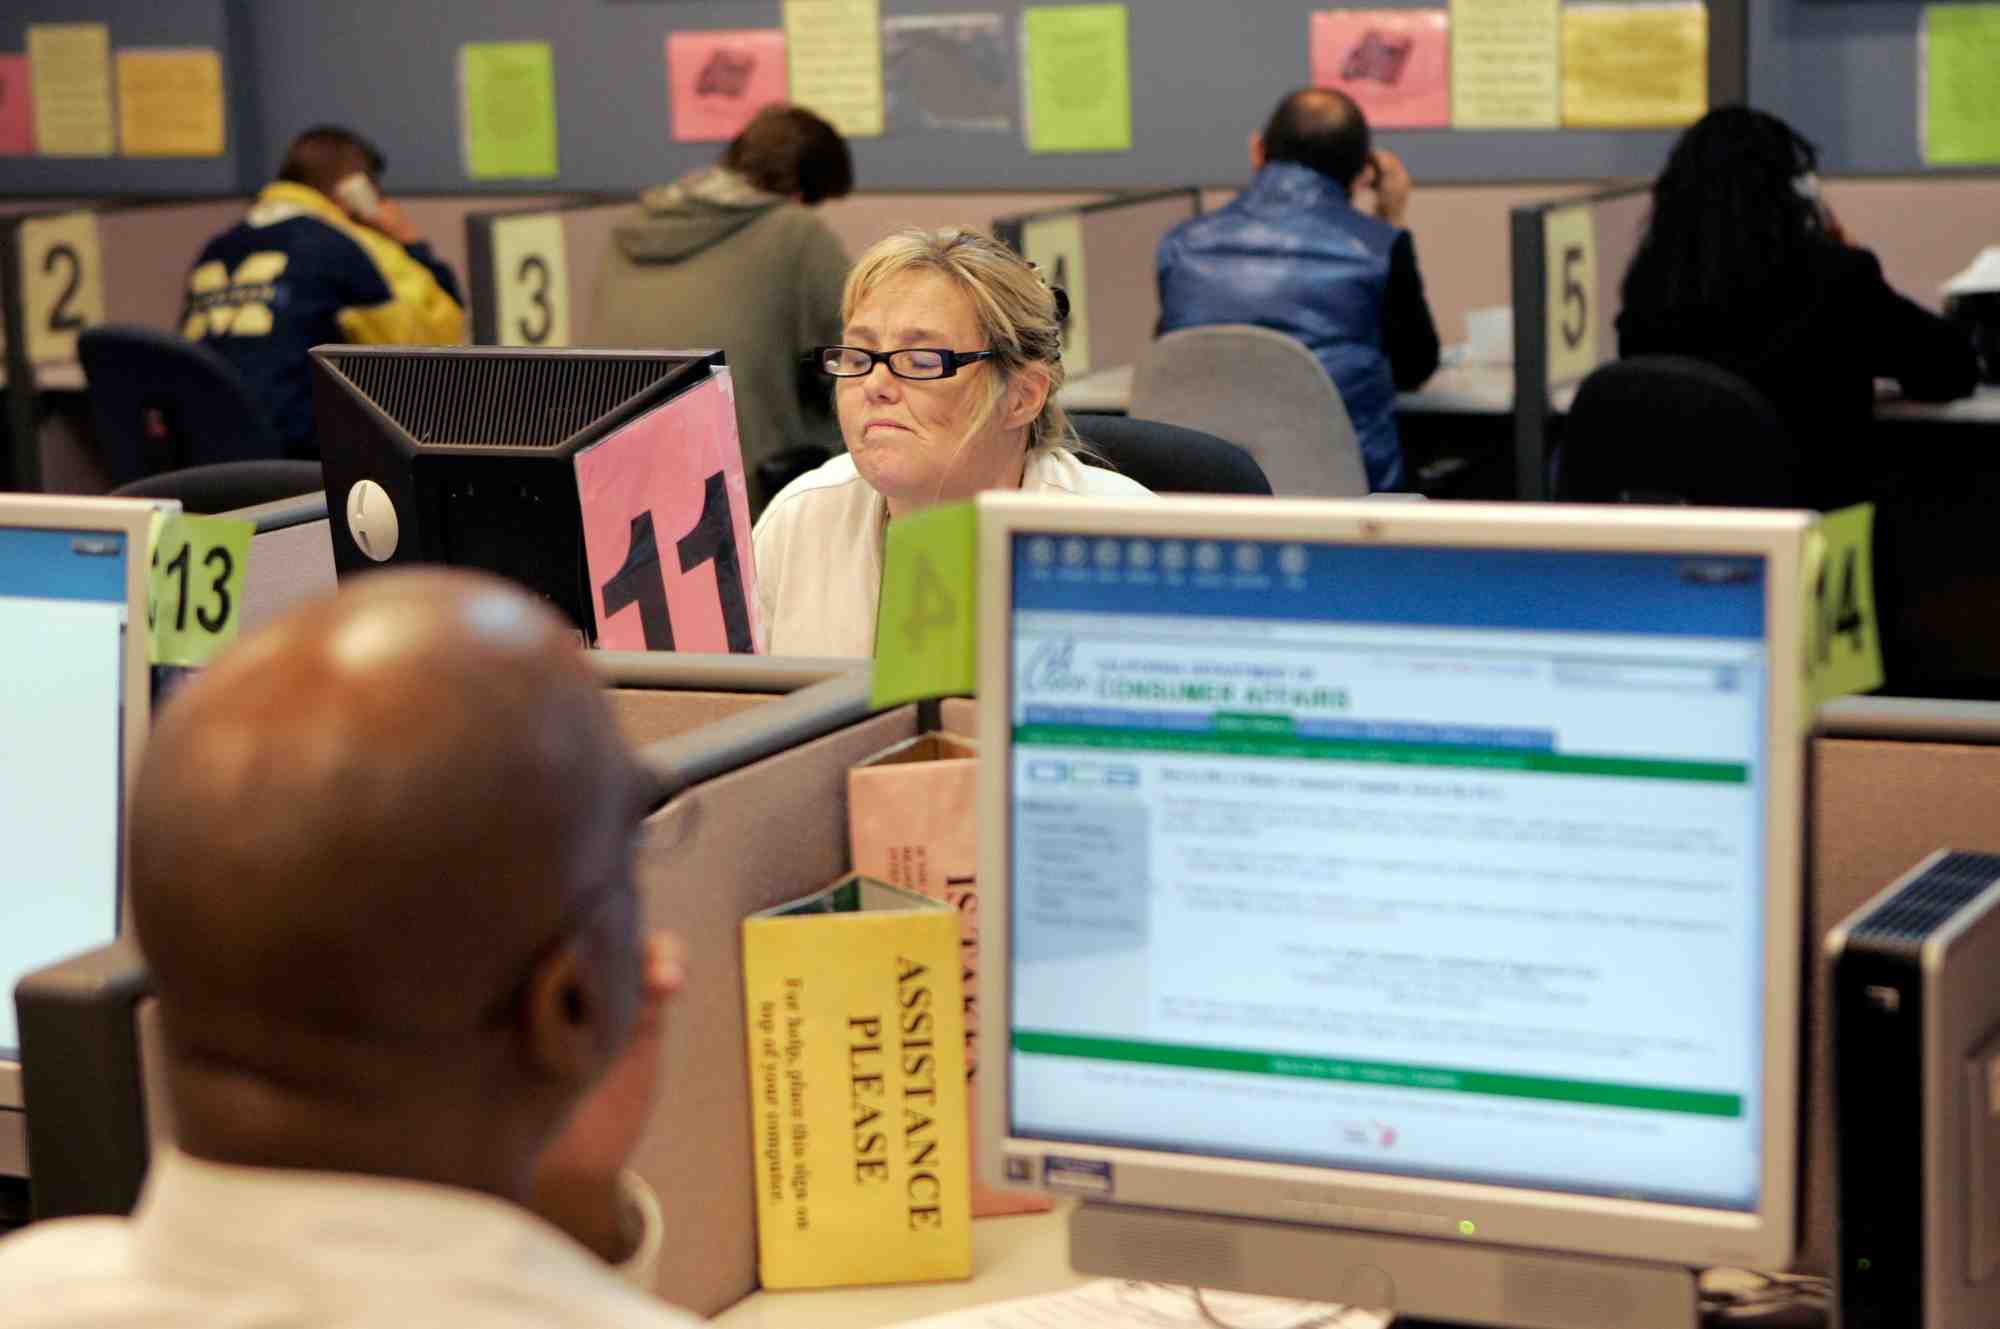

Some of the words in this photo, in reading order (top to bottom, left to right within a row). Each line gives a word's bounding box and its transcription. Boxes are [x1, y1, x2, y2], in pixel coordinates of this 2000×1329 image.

[43, 245, 84, 331] 2
[517, 255, 552, 343] 3
[1562, 246, 1585, 349] 5
[601, 470, 755, 653] 11
[785, 977, 803, 1010] For
[763, 1038, 781, 1057] of
[760, 1062, 779, 1106] your
[784, 1069, 808, 1117] place
[849, 1015, 889, 1184] PLEASE
[897, 956, 942, 1231] ASSISTANCE
[791, 1123, 810, 1157] this
[791, 1163, 813, 1199] sign
[795, 1205, 810, 1232] on
